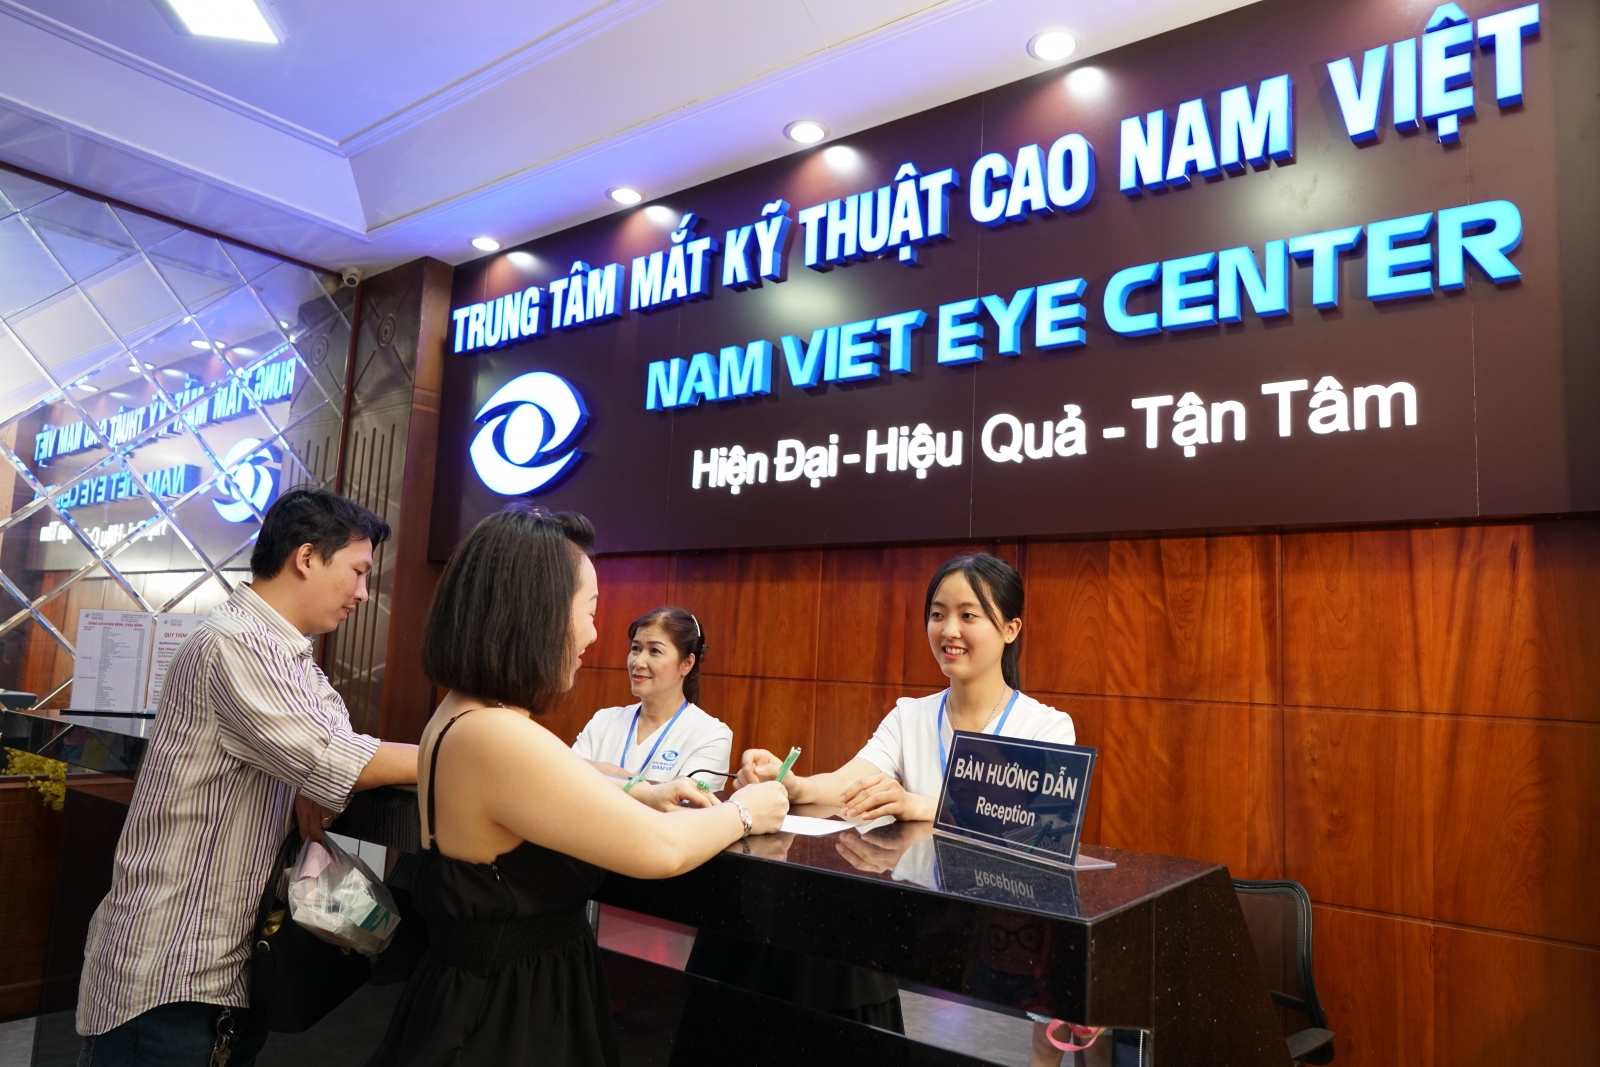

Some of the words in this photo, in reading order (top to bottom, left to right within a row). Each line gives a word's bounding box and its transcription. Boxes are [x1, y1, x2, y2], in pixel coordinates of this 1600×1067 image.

[453, 286, 547, 353] TRUNG
[550, 260, 624, 329] TÂM
[630, 212, 718, 311] MẮT
[722, 199, 791, 287] KỸ
[799, 162, 959, 270] THUẬT
[970, 133, 1095, 228] CAO
[1120, 74, 1293, 196] NAM
[1327, 2, 1540, 145] VIỆT
[646, 339, 772, 411] NAM
[781, 310, 928, 389] VIET
[937, 278, 1088, 366] EYE
[1104, 200, 1523, 337] CENTER
[692, 445, 767, 495] Hiện
[774, 434, 838, 488] Đại
[866, 423, 963, 479] Hiệu
[981, 404, 1087, 464] Quả
[1132, 392, 1246, 457] Tận
[1261, 375, 1417, 438] Tâm
[954, 755, 985, 782] BÀN
[985, 762, 1039, 793] HƯỚNG
[1042, 766, 1078, 800] DẪN
[975, 796, 1036, 827] Reception
